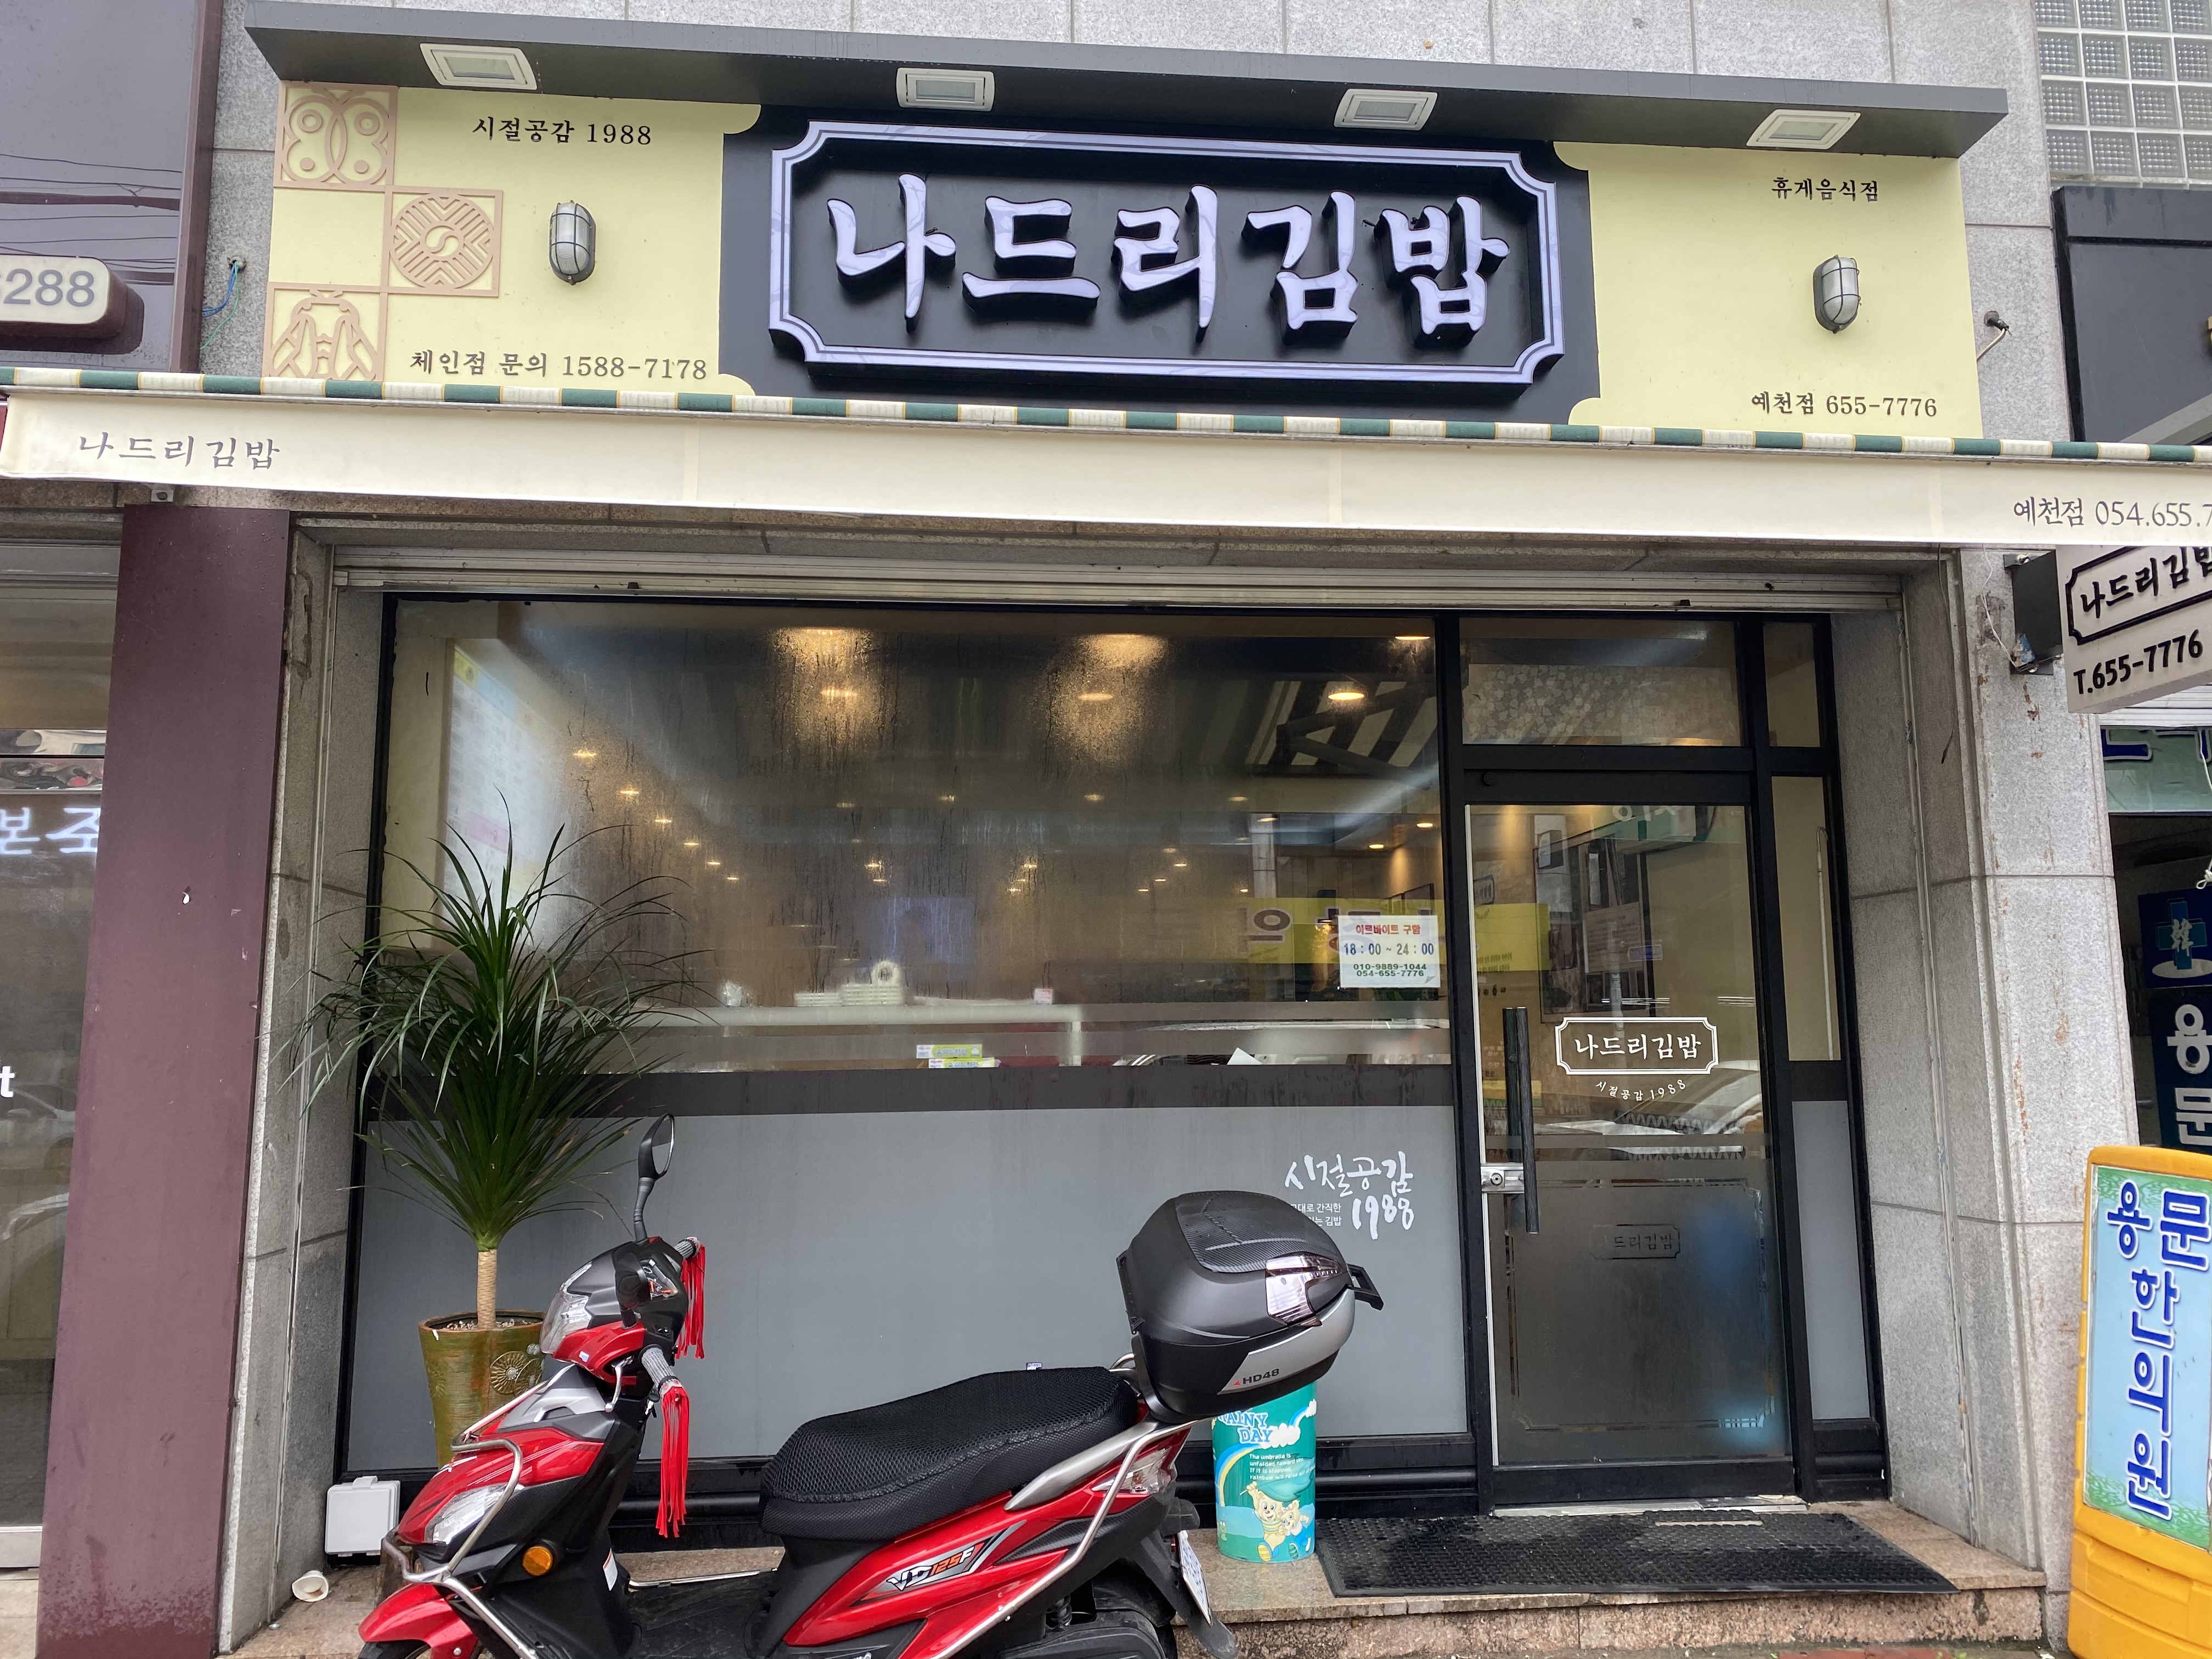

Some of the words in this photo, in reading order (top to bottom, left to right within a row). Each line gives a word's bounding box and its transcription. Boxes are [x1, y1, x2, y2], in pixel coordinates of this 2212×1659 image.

[472, 116, 575, 143] 시절공감
[586, 123, 652, 145] 1988
[1771, 177, 1879, 202] 휴게음식점
[827, 172, 1510, 336] 나드리김밥
[409, 349, 486, 375] 체인점
[499, 352, 548, 377] 문의
[562, 355, 708, 380] 1588-7178
[1751, 391, 1814, 415] 예천점
[1826, 394, 1937, 417] 655-7776
[79, 432, 280, 470] 나드리김밥
[2013, 496, 2084, 527] 예천점
[2074, 629, 2203, 696] T.655-7776
[1356, 924, 1399, 935] 아르바이트
[1403, 924, 1421, 935] 구함
[1575, 1034, 1701, 1059] 나드리김밥
[1595, 1081, 1644, 1102] 시절공감
[1650, 1079, 1686, 1100] 1988
[1284, 1150, 1414, 1198] 시절공감
[1317, 1203, 1342, 1213] 간직한
[1352, 1194, 1414, 1240] 1988
[1325, 1216, 1342, 1227] 김밥
[1601, 1233, 1675, 1251] 드리김밥
[1242, 1368, 1280, 1386] HD48
[1238, 1427, 1273, 1443] DAY
